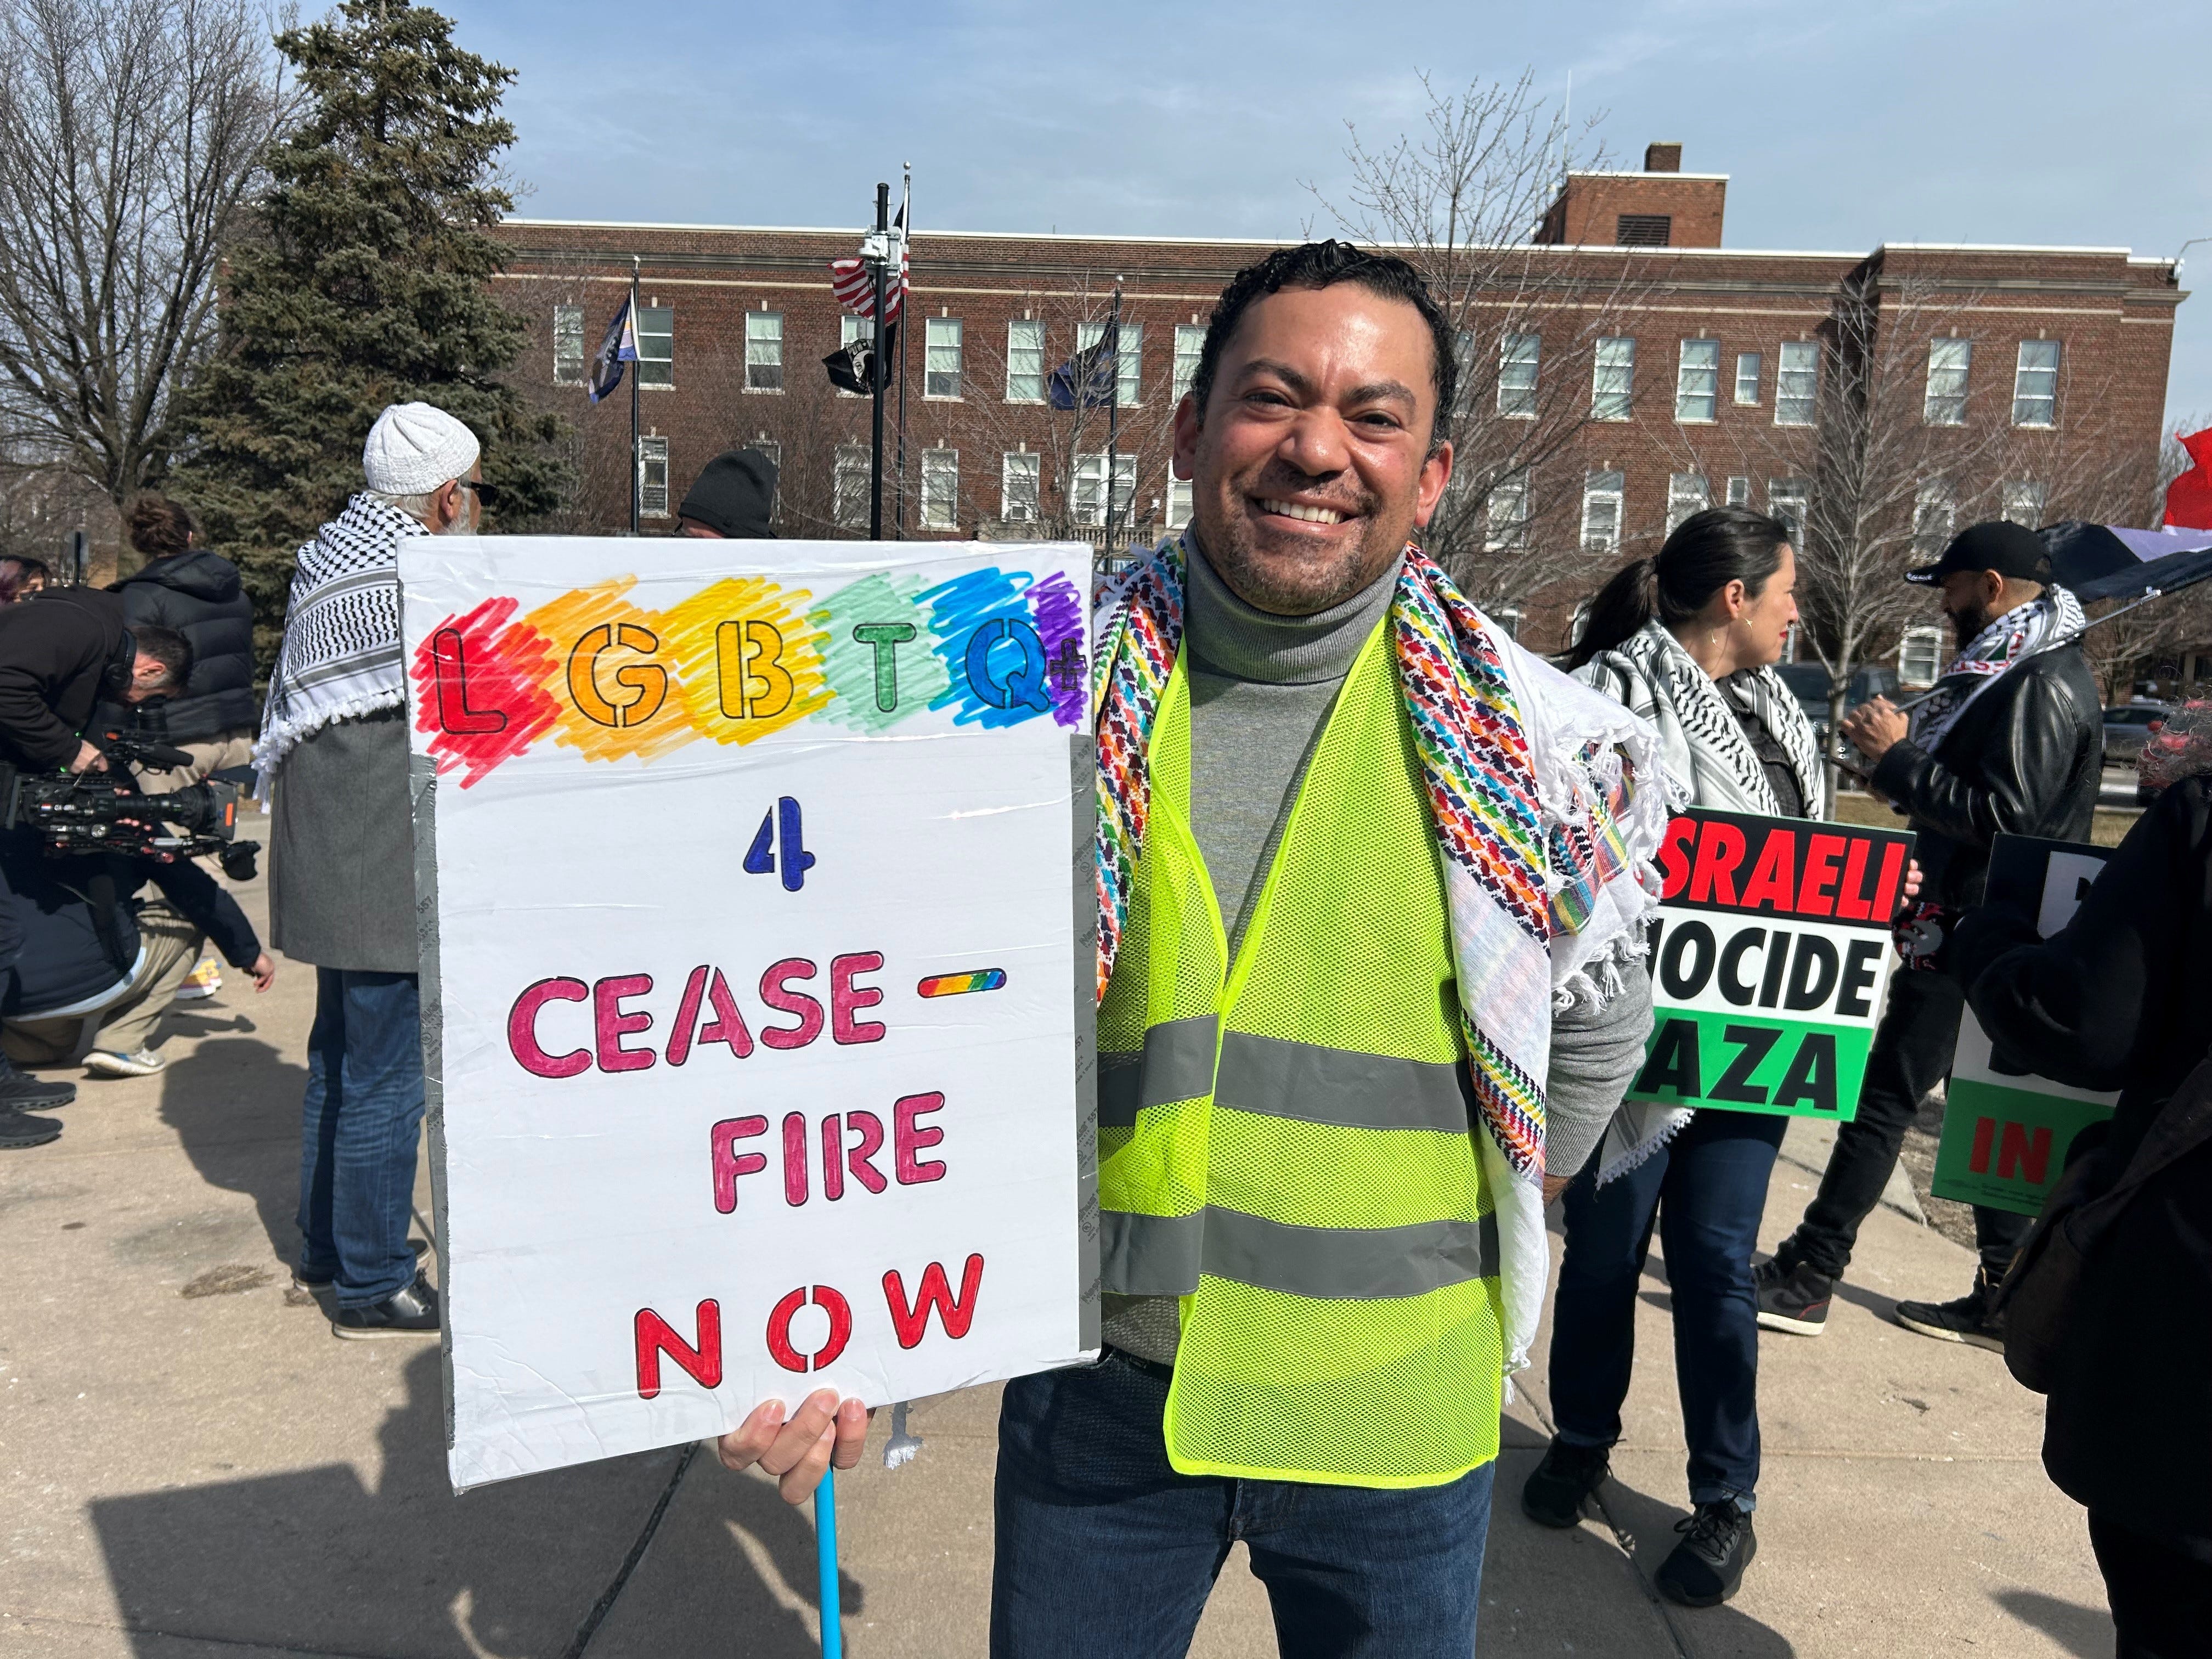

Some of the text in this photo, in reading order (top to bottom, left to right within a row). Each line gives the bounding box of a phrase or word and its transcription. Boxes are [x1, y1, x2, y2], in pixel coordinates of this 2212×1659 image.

[433, 618, 1087, 735] LGBTQ+
[742, 796, 815, 892] 4
[1656, 817, 1906, 922] SRAELI
[1646, 918, 1884, 1017] OCIDE
[1633, 1017, 1837, 1111] AZA
[710, 1091, 947, 1215] FIRE
[1969, 1116, 2053, 1185] IN
[634, 1252, 984, 1400] NOW
